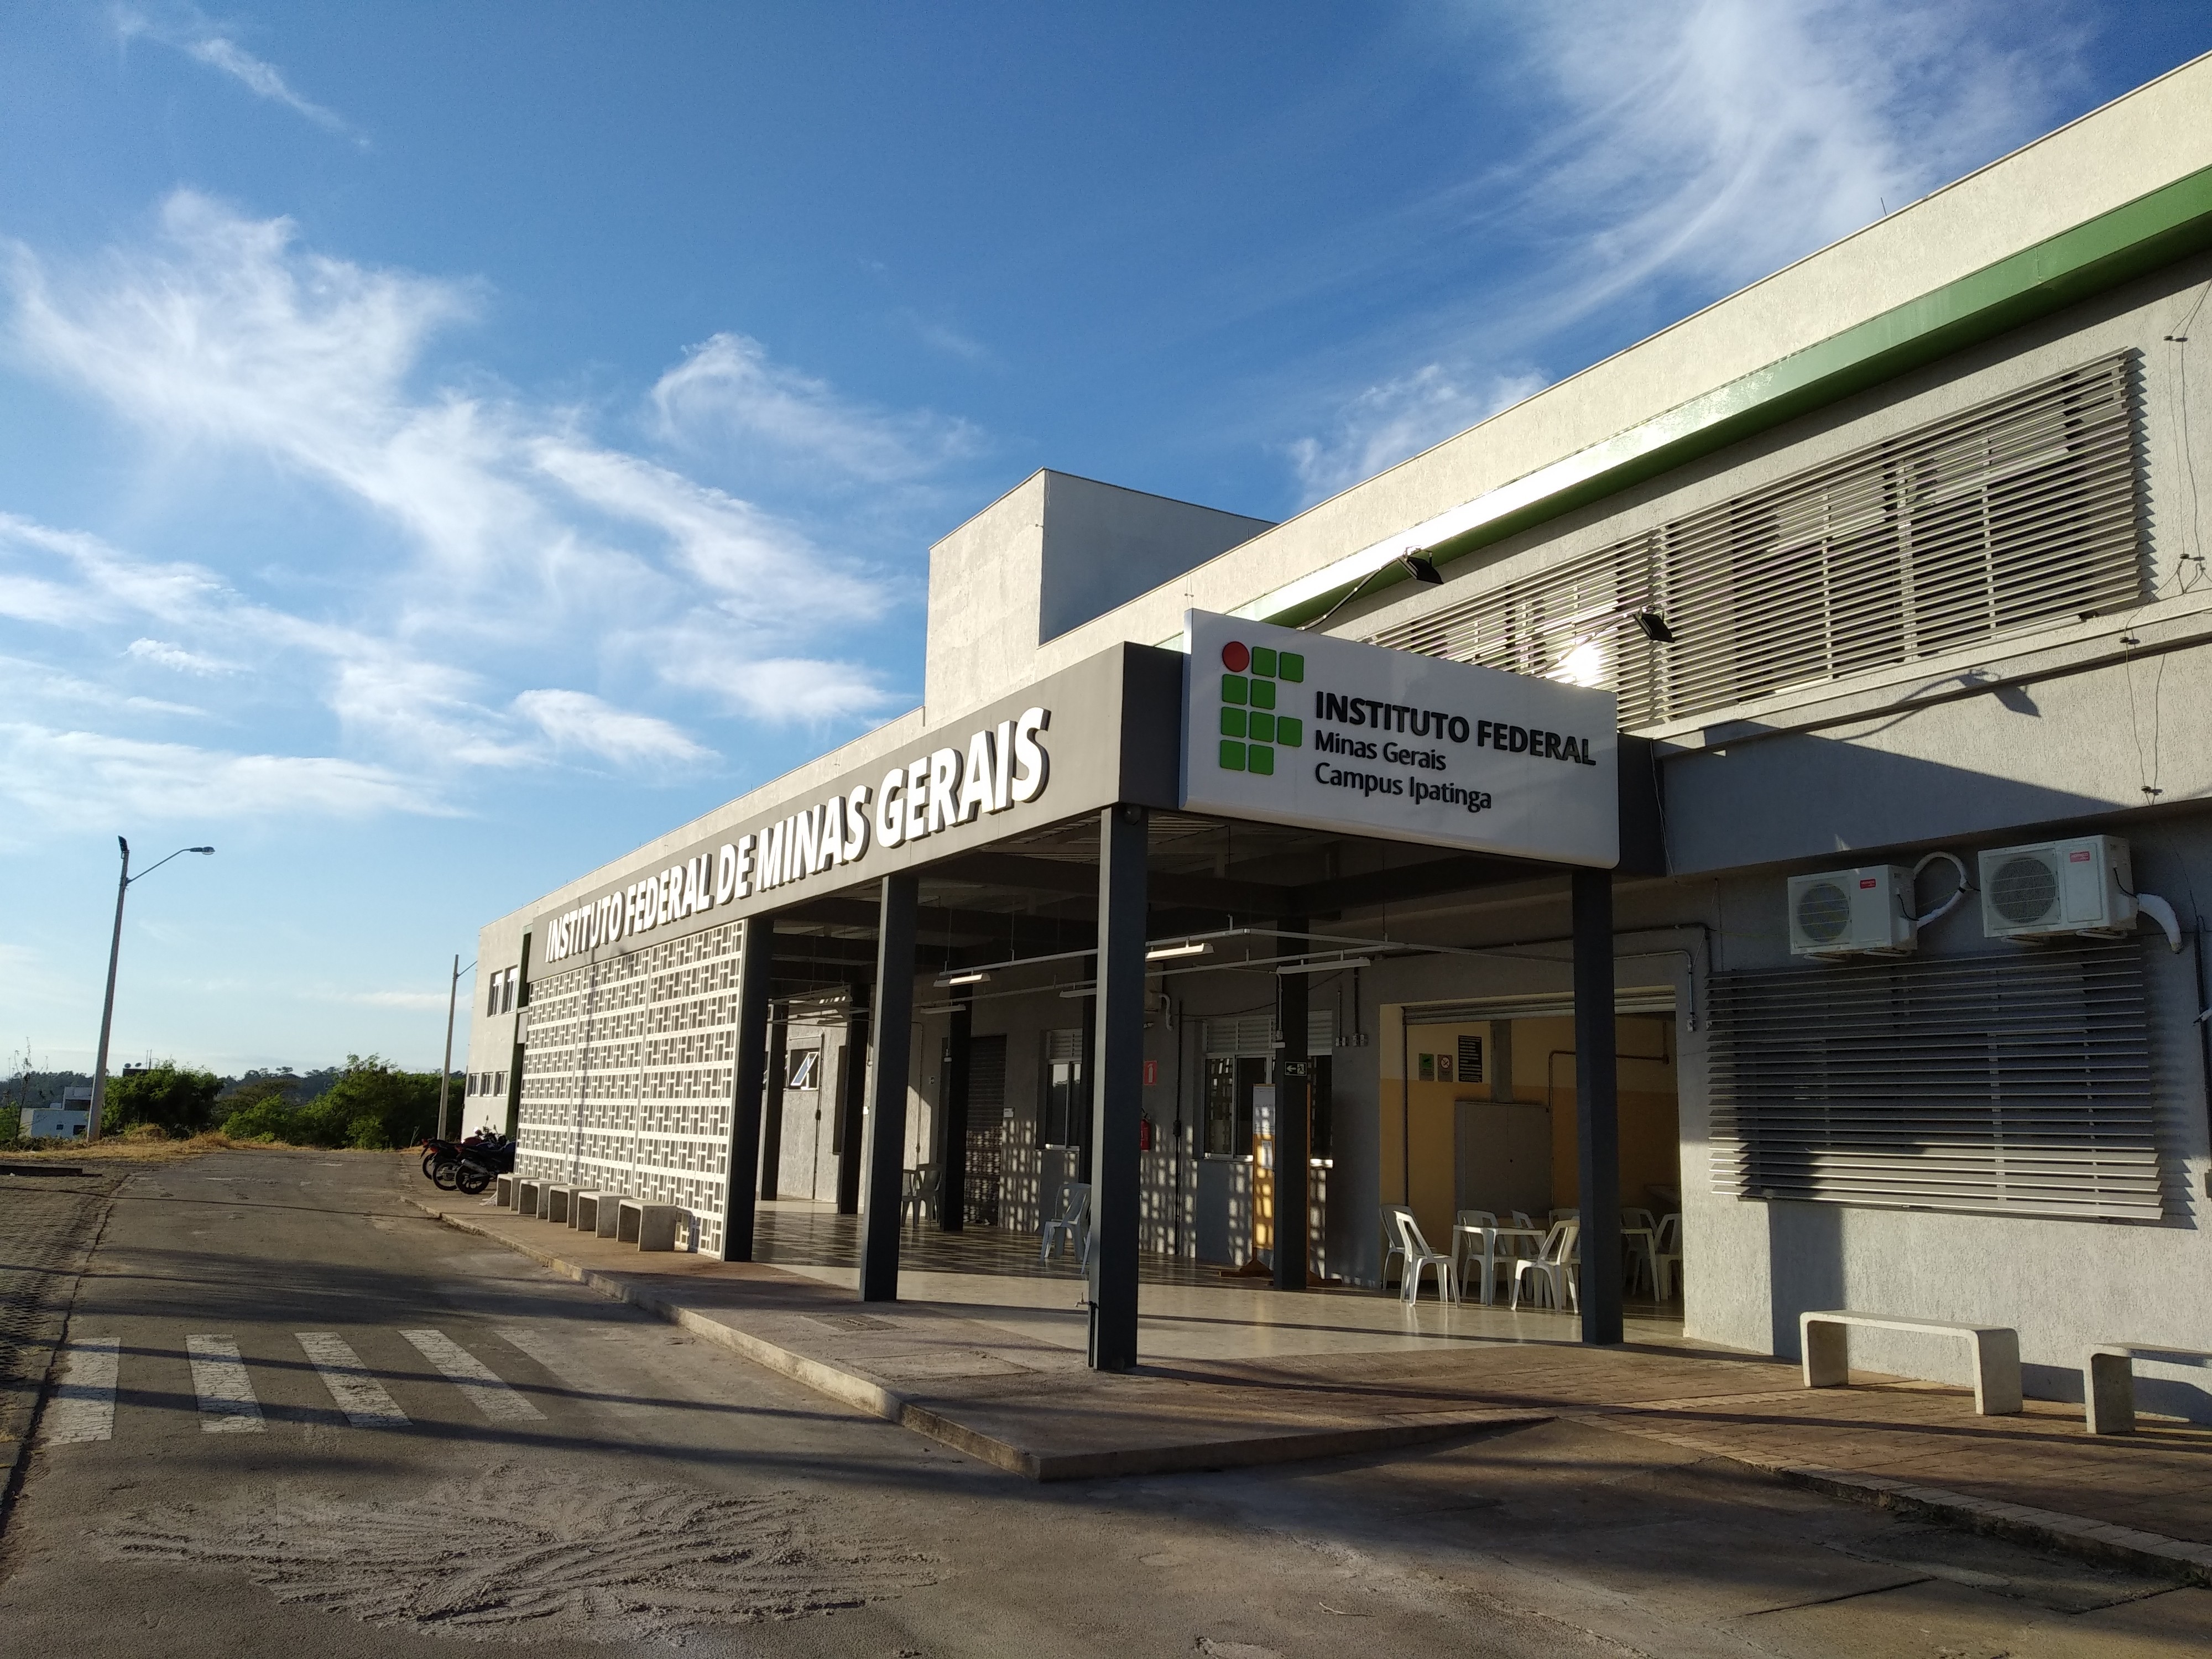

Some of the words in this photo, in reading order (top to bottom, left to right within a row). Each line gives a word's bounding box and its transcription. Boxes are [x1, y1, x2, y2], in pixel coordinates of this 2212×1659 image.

[1315, 729, 1378, 760] Minas
[1383, 742, 1447, 771] Gerais
[1316, 691, 1470, 743] INSTITUTO
[1477, 720, 1597, 766] FEDERAL
[1315, 762, 1404, 797] Campus
[1409, 776, 1492, 813] Ipatinga
[545, 890, 624, 963] INSTITUTO
[625, 853, 714, 936] FEDERAL
[716, 834, 756, 905] DE
[756, 784, 873, 892] MINAS
[877, 706, 1052, 848] GERAIS
